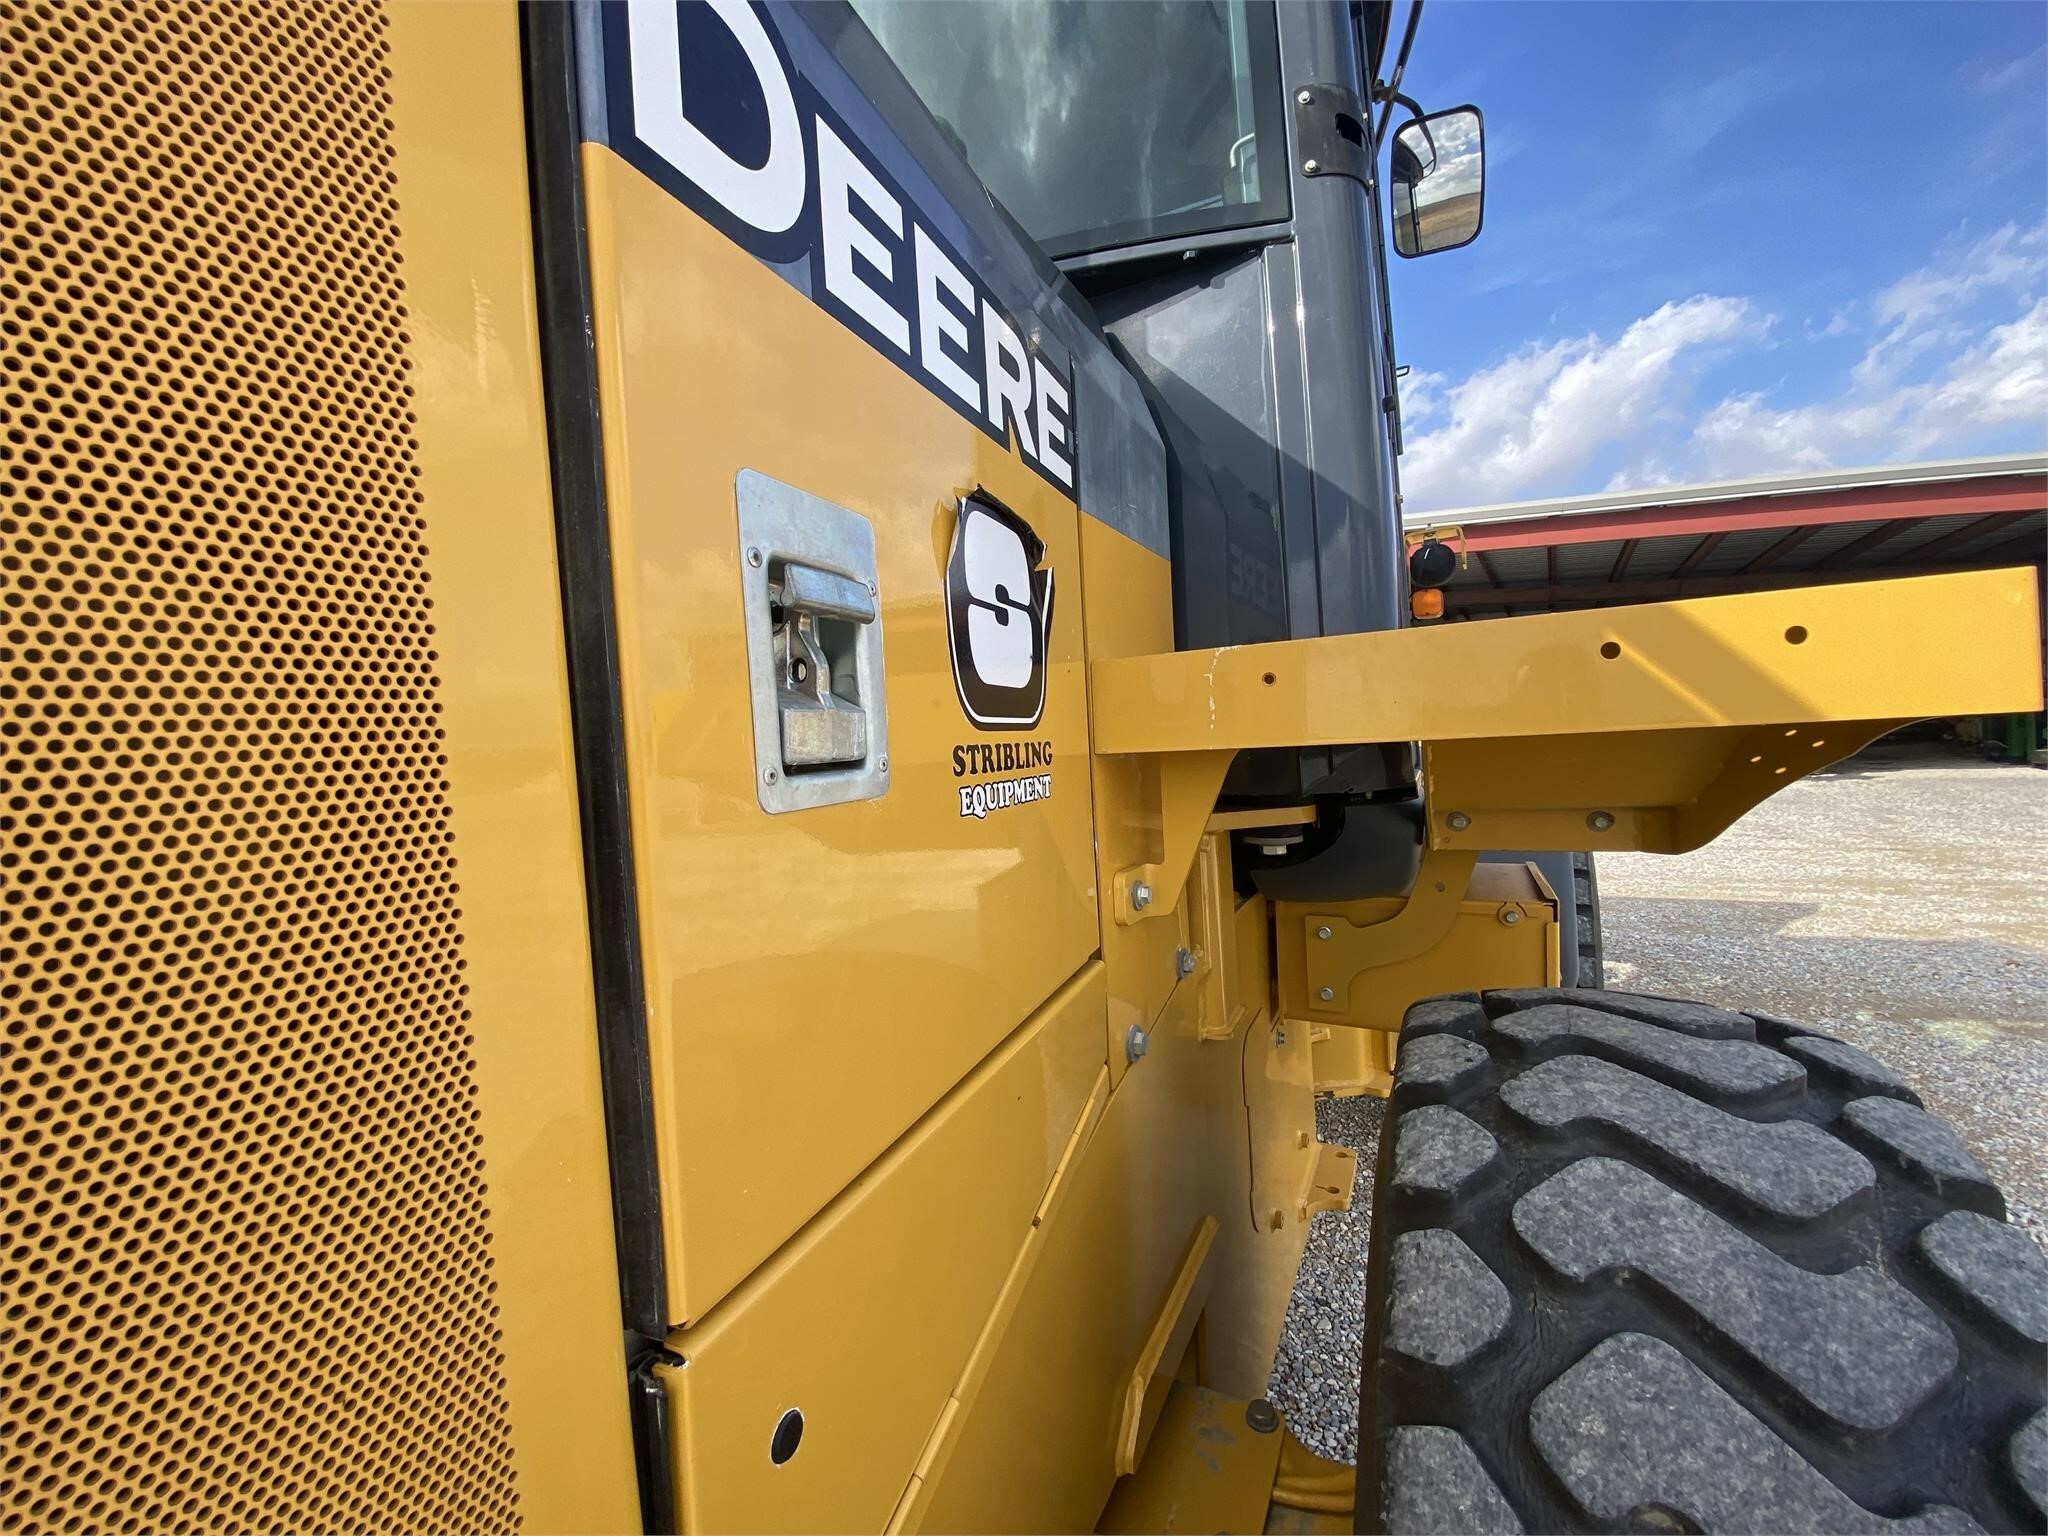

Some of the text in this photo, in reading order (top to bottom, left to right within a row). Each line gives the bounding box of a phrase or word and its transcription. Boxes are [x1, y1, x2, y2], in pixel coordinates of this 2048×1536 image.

[628, 0, 1073, 488] DEERE
[952, 740, 1053, 777] STRIBLING
[959, 774, 1052, 819] EQUIPMENT
